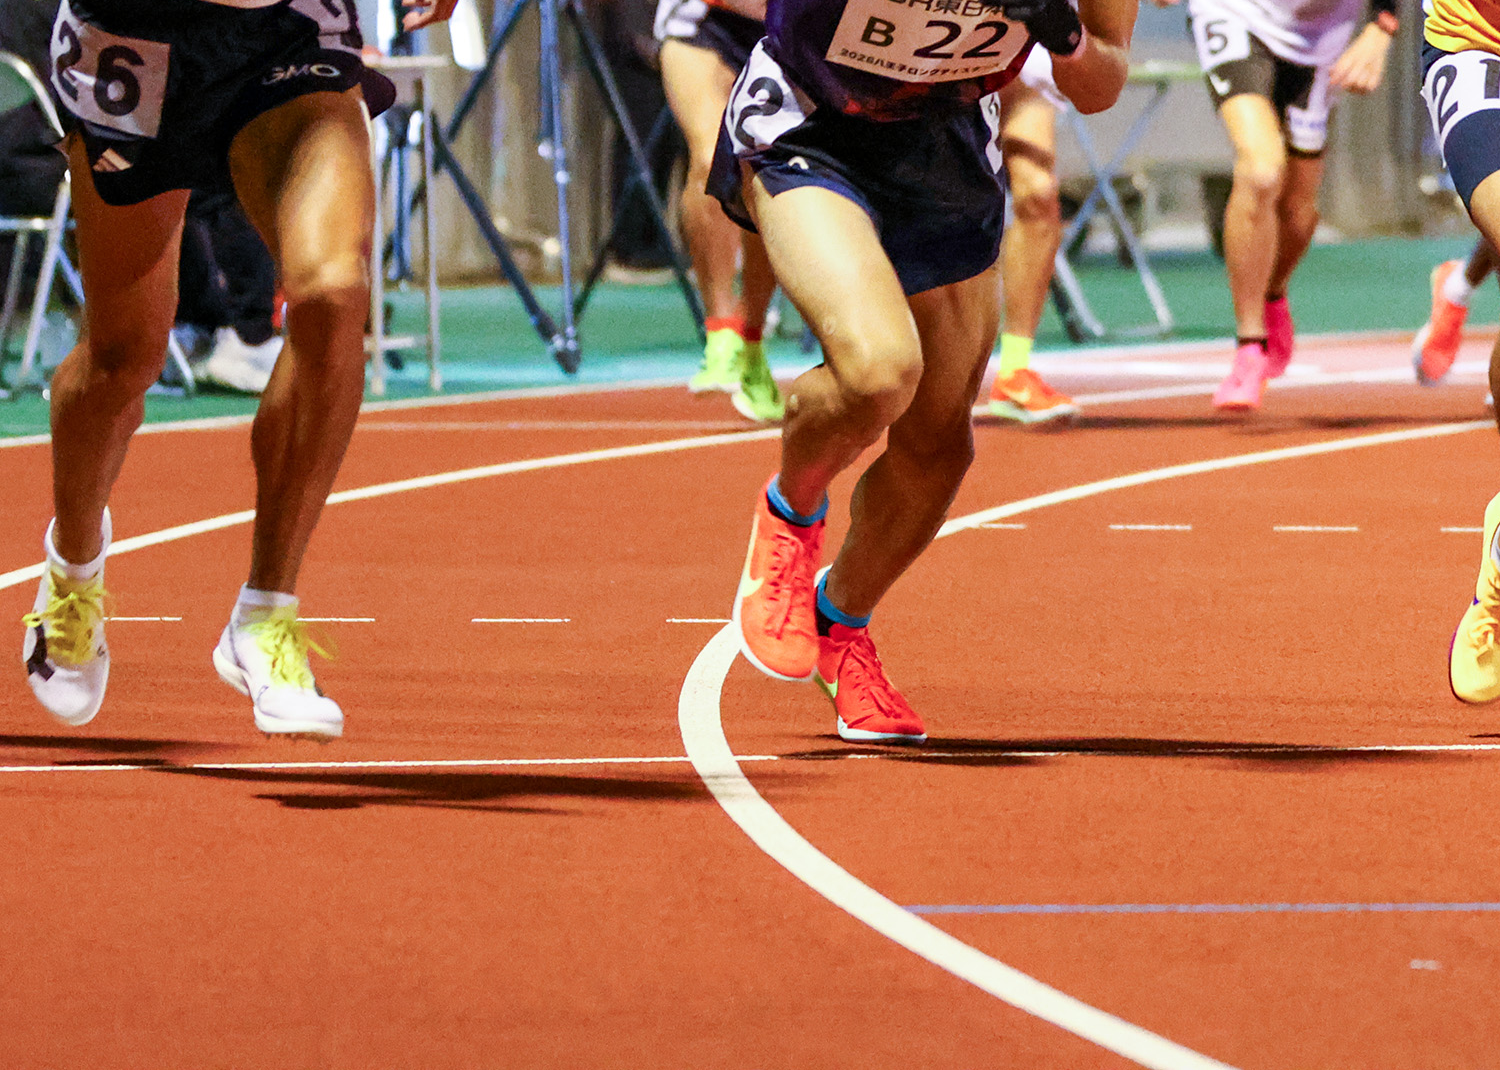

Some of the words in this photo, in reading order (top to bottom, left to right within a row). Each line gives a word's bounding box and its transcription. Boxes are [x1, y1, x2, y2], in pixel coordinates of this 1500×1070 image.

[56, 20, 144, 117] 26
[861, 16, 896, 47] B
[912, 20, 1009, 60] 22
[732, 60, 784, 149] 2
